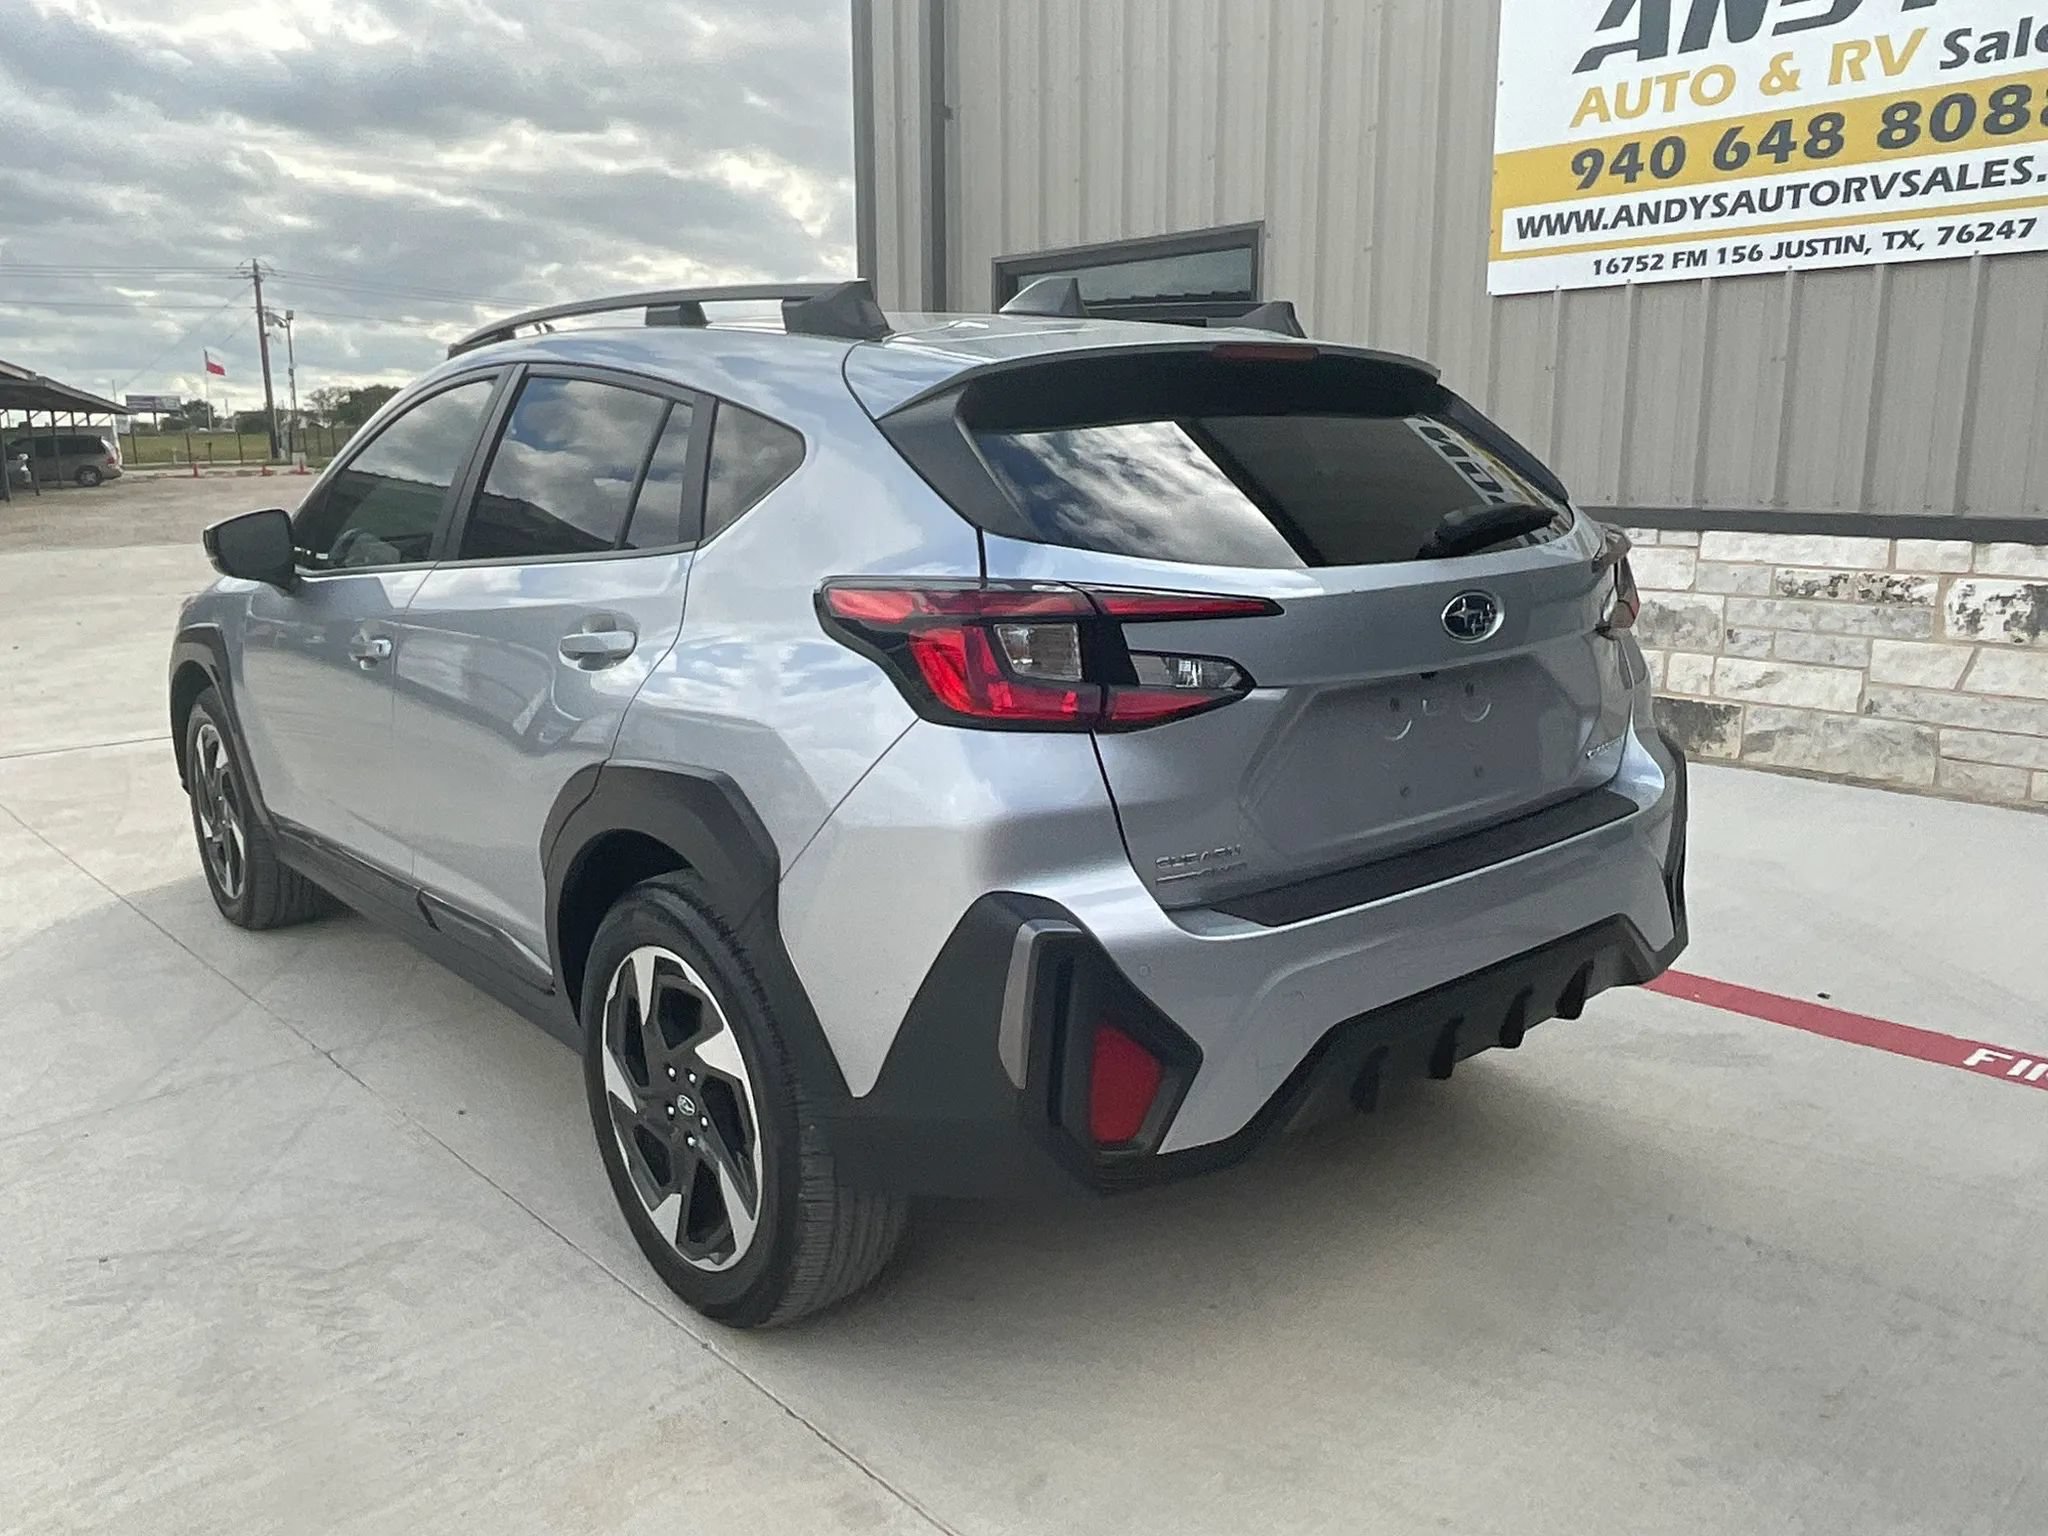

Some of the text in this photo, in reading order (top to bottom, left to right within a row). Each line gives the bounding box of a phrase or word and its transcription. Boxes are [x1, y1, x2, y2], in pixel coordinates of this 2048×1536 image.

[1570, 64, 1736, 128] AUTO
[1759, 51, 1803, 96] &
[1828, 27, 1928, 86] RV
[1571, 84, 2048, 190] 940 648 808
[1593, 217, 2038, 275] 16752 FM 156 JUSTIN, TX, 76247
